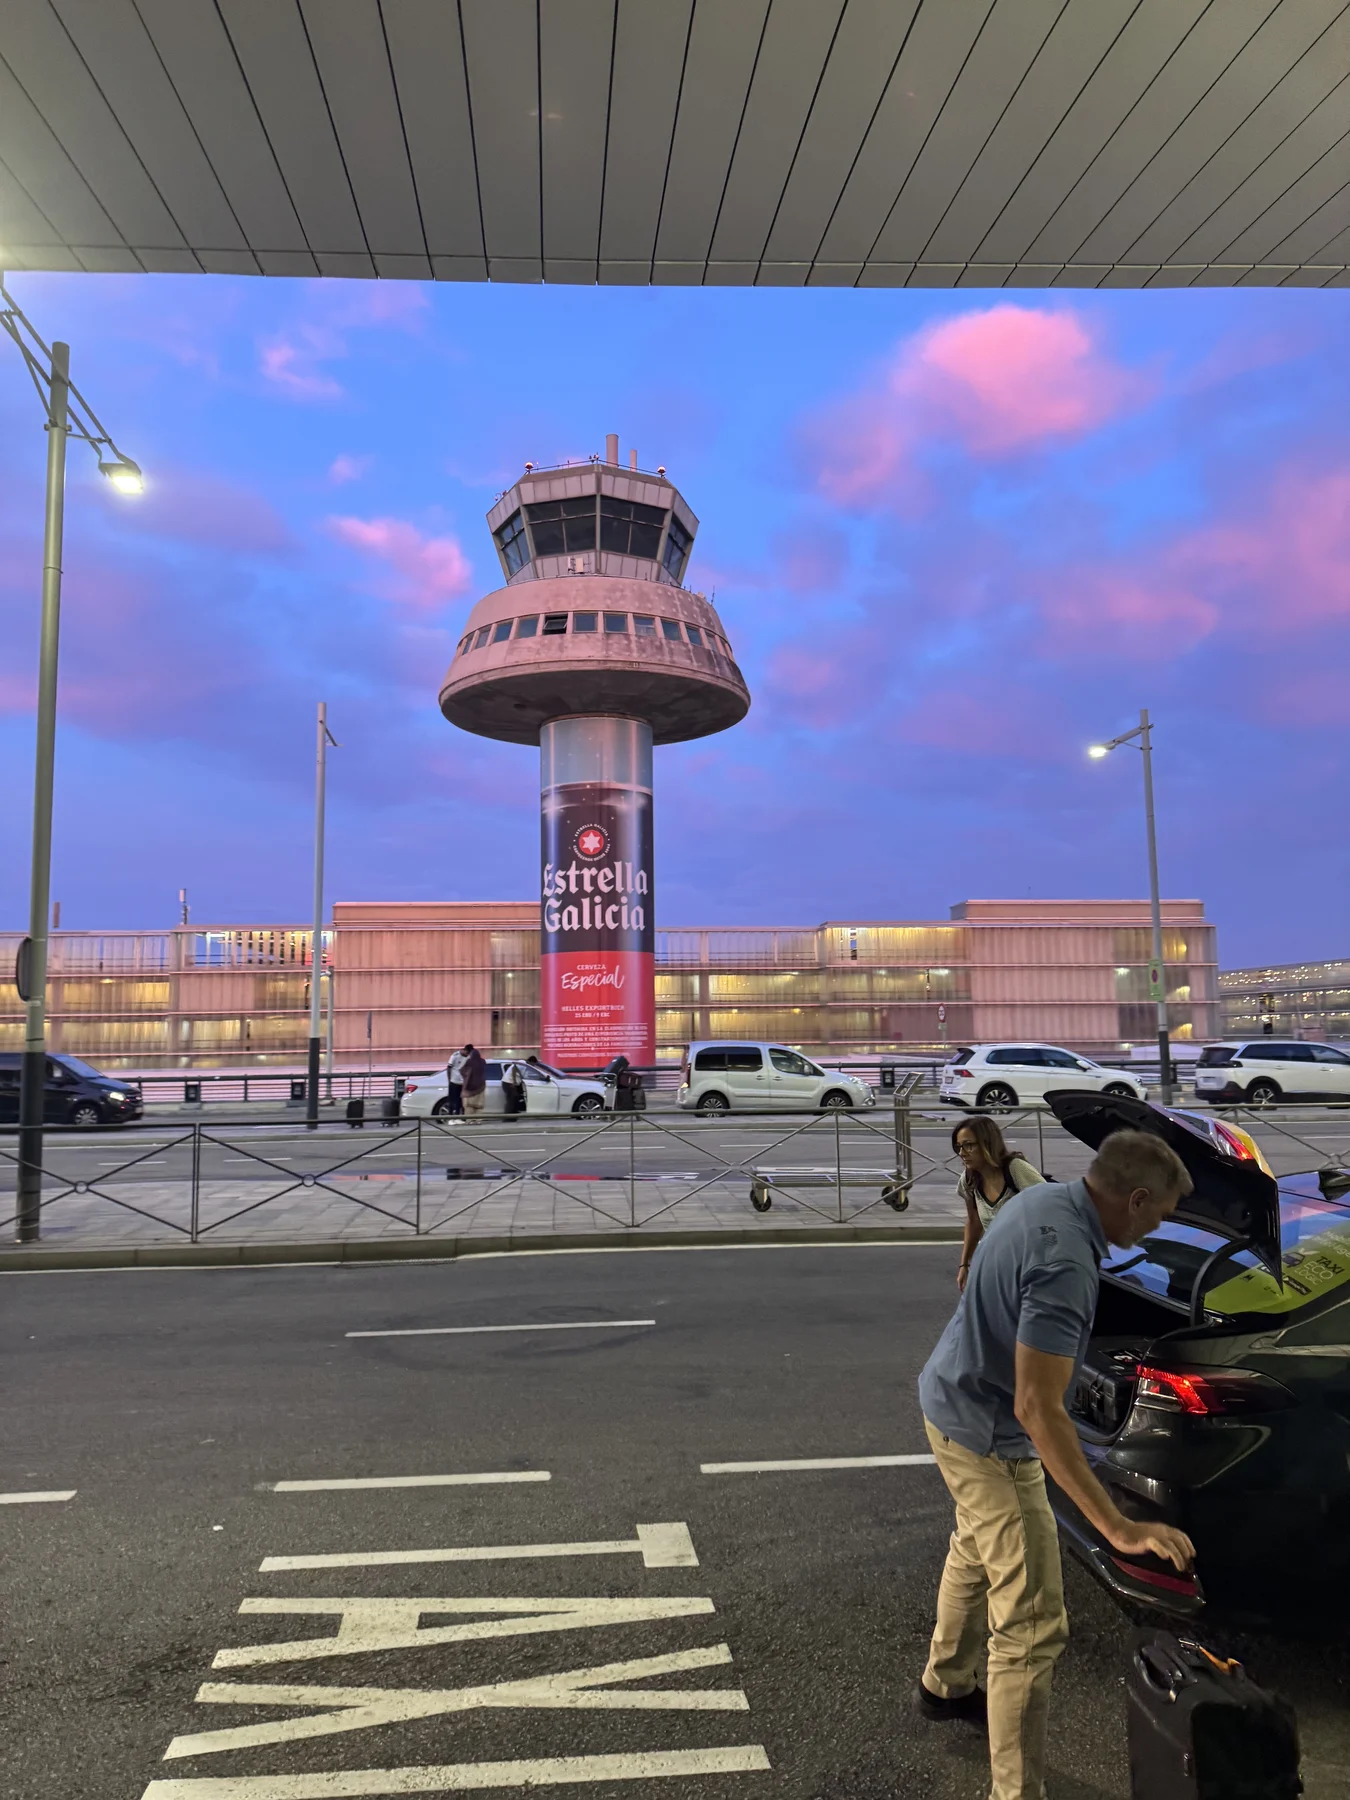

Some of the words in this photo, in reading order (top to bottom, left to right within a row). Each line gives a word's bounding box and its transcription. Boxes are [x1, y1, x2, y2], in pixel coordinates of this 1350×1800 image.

[543, 860, 649, 897] Estrella
[544, 895, 646, 933] Galicia
[561, 965, 624, 992] Especial
[1304, 1261, 1333, 1279] ECO
[1316, 1256, 1344, 1274] TAXI
[141, 1521, 772, 1800] TAXI
